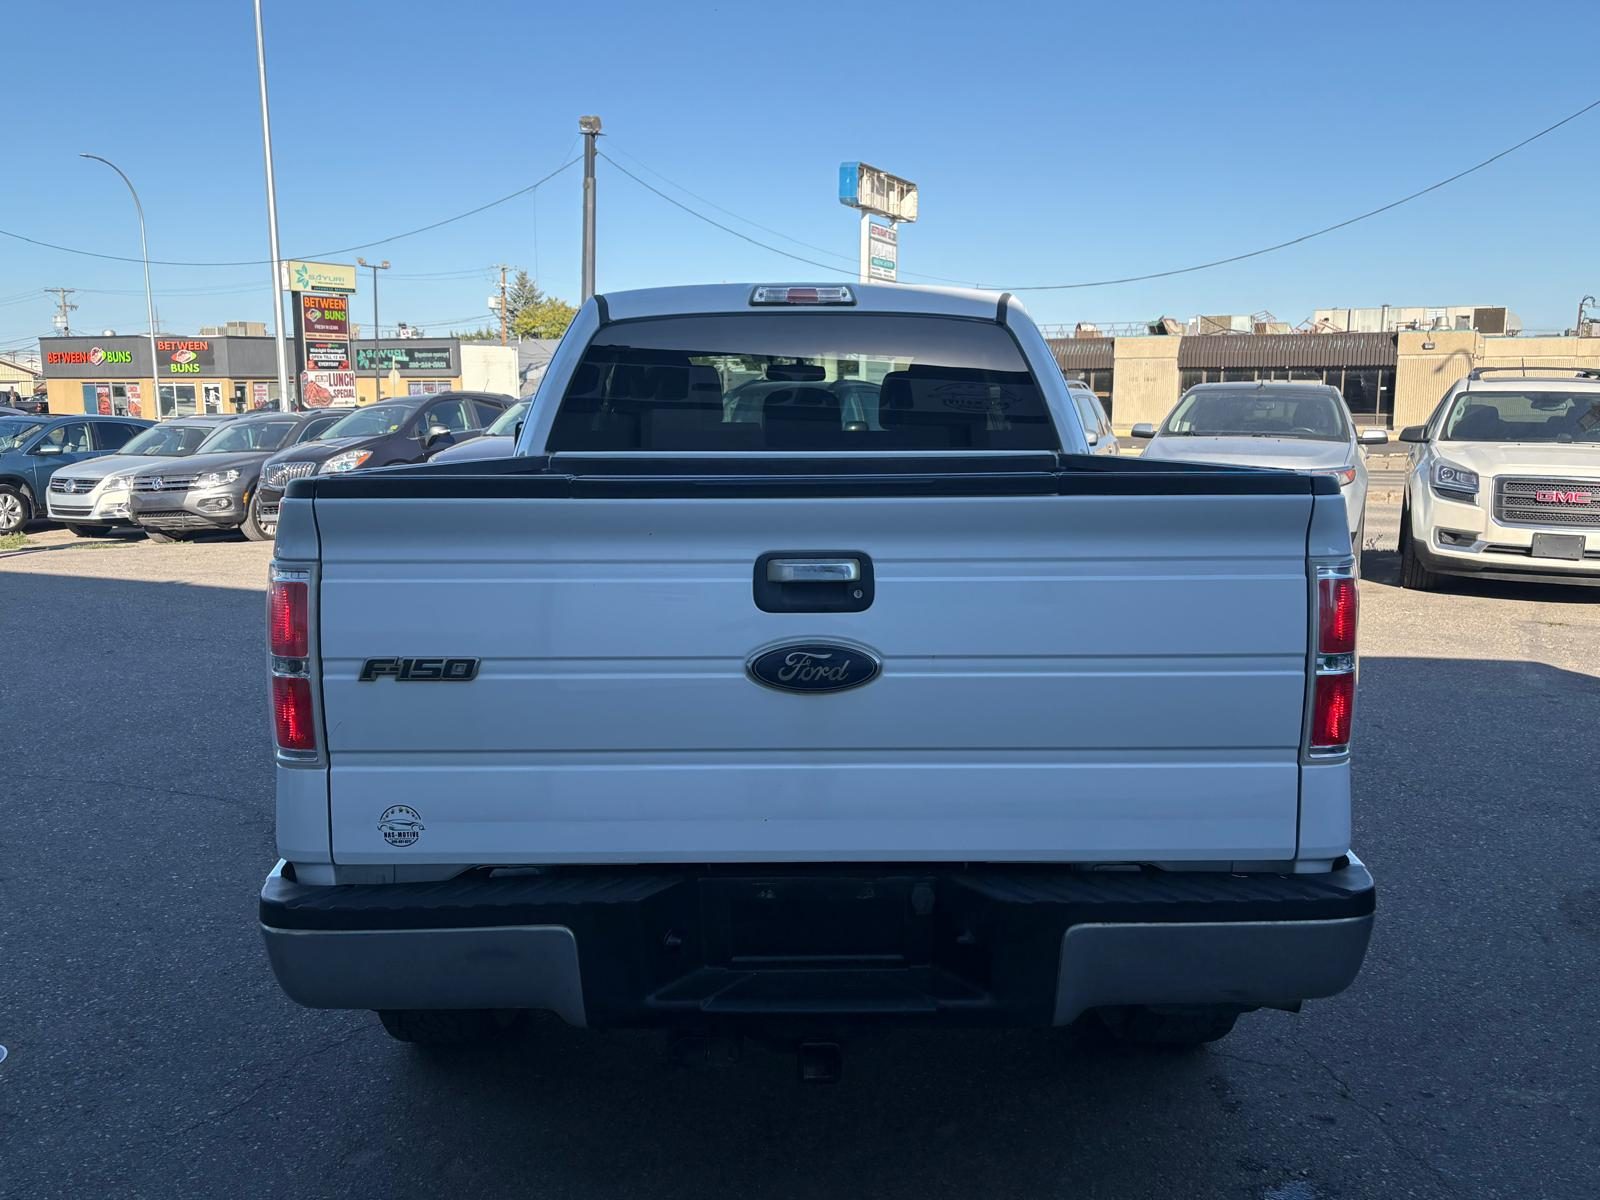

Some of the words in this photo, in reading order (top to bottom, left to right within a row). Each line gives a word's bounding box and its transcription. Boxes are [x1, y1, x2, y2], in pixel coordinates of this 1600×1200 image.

[304, 297, 346, 309] BETWEEN
[325, 310, 346, 321] BUNS
[157, 341, 209, 351] BETWEEN
[47, 351, 87, 364] BETWEEN
[107, 351, 133, 364] BUNS
[170, 363, 200, 373] BUNS
[328, 373, 355, 387] LUNCH
[333, 388, 355, 399] SPECIAL
[1536, 491, 1592, 504] GMC
[358, 656, 480, 682] F-150
[777, 651, 850, 681] Ford
